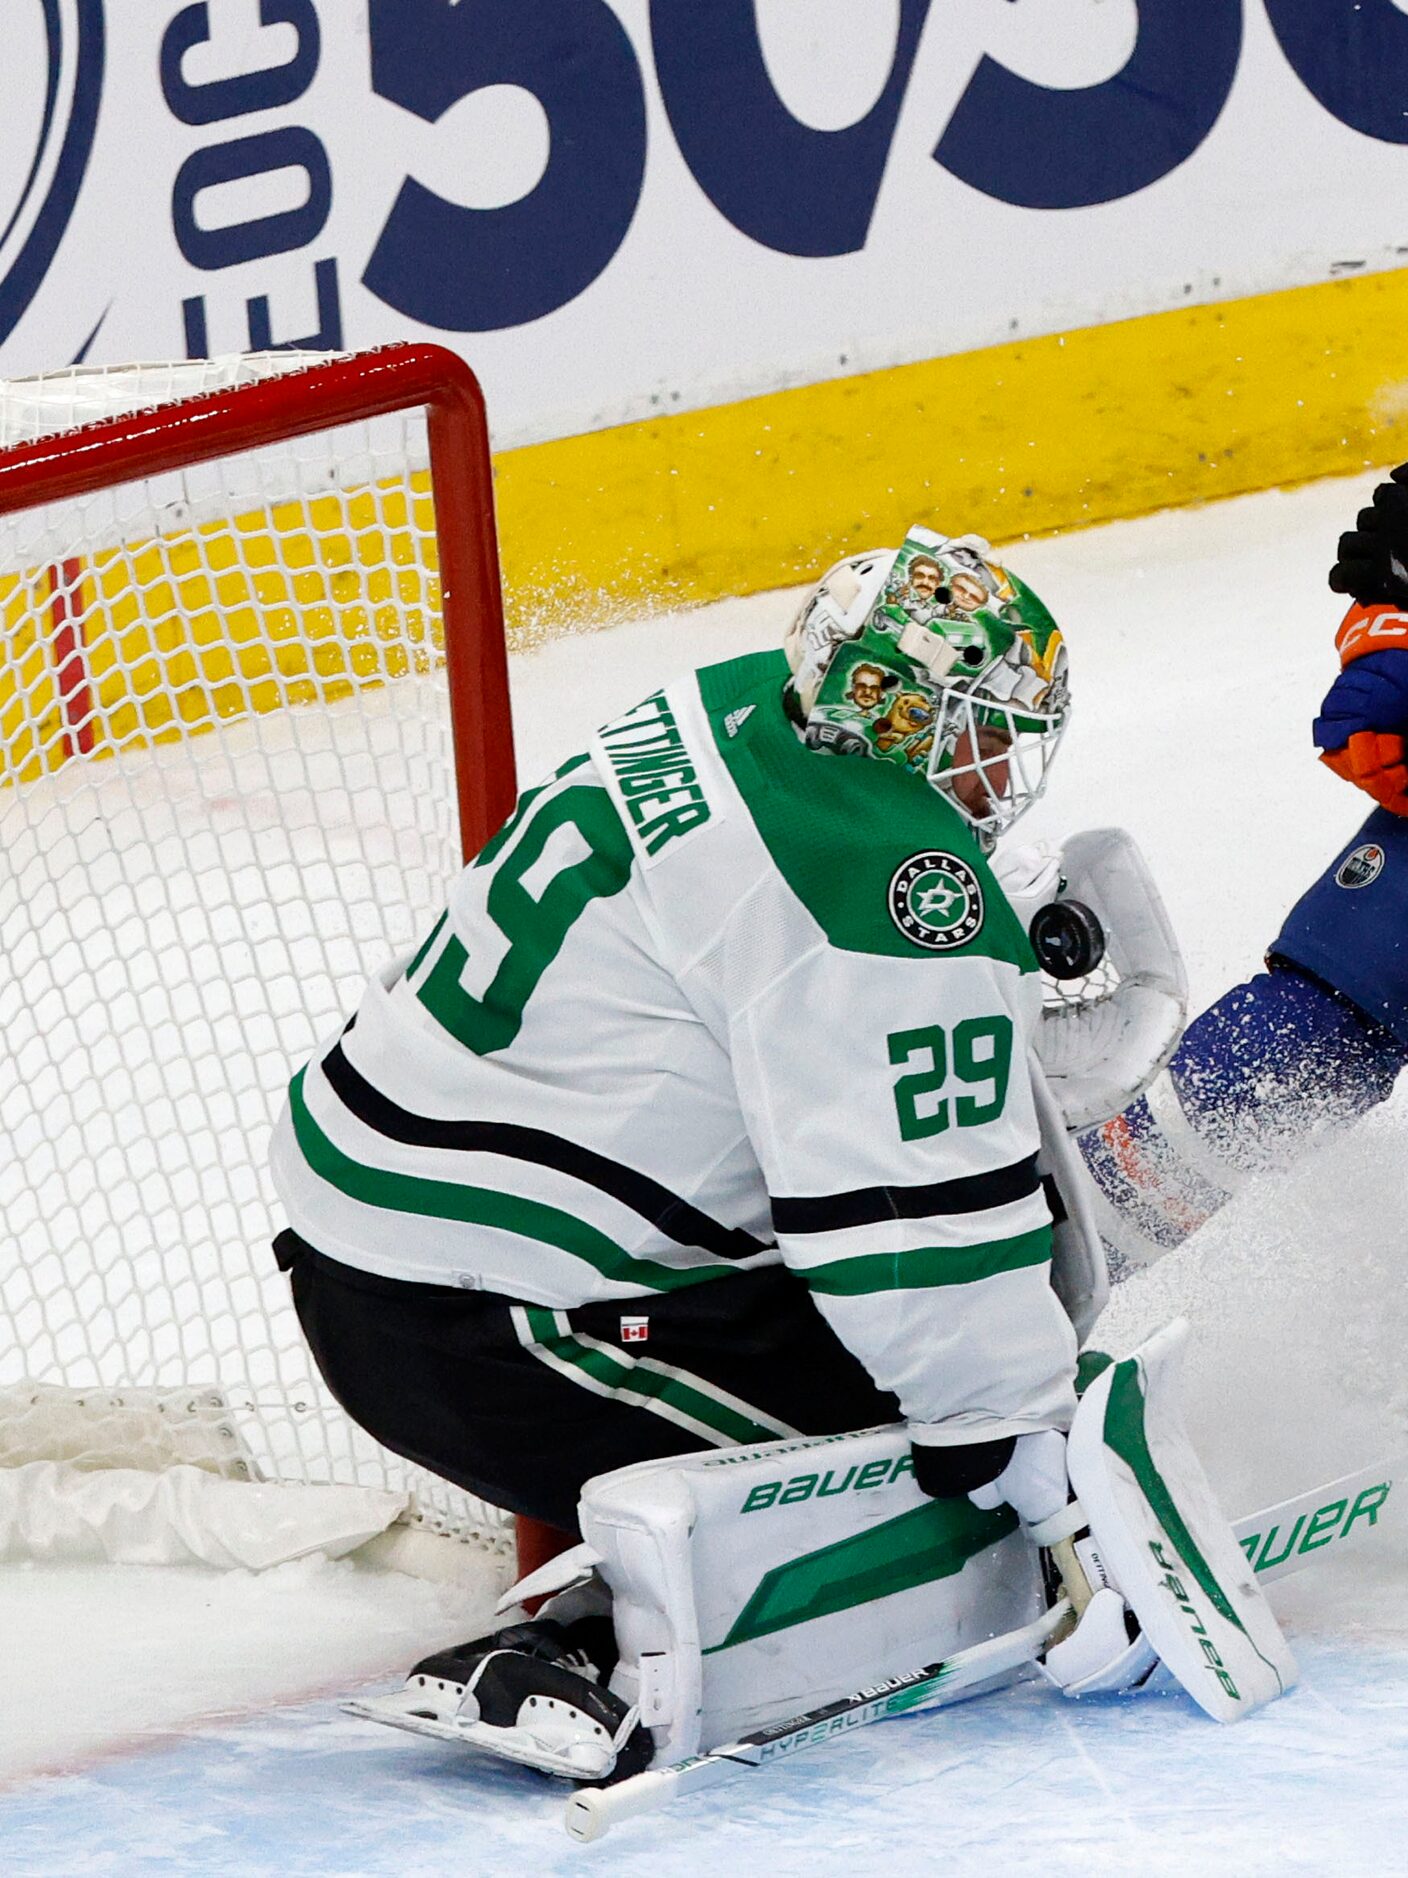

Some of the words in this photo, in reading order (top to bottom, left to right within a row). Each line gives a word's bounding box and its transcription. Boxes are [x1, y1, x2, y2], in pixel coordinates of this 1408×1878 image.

[896, 859, 977, 896] DALLAS
[902, 915, 977, 943] STARS
[887, 1014, 1014, 1141] 29
[860, 1668, 930, 1699] BAUER
